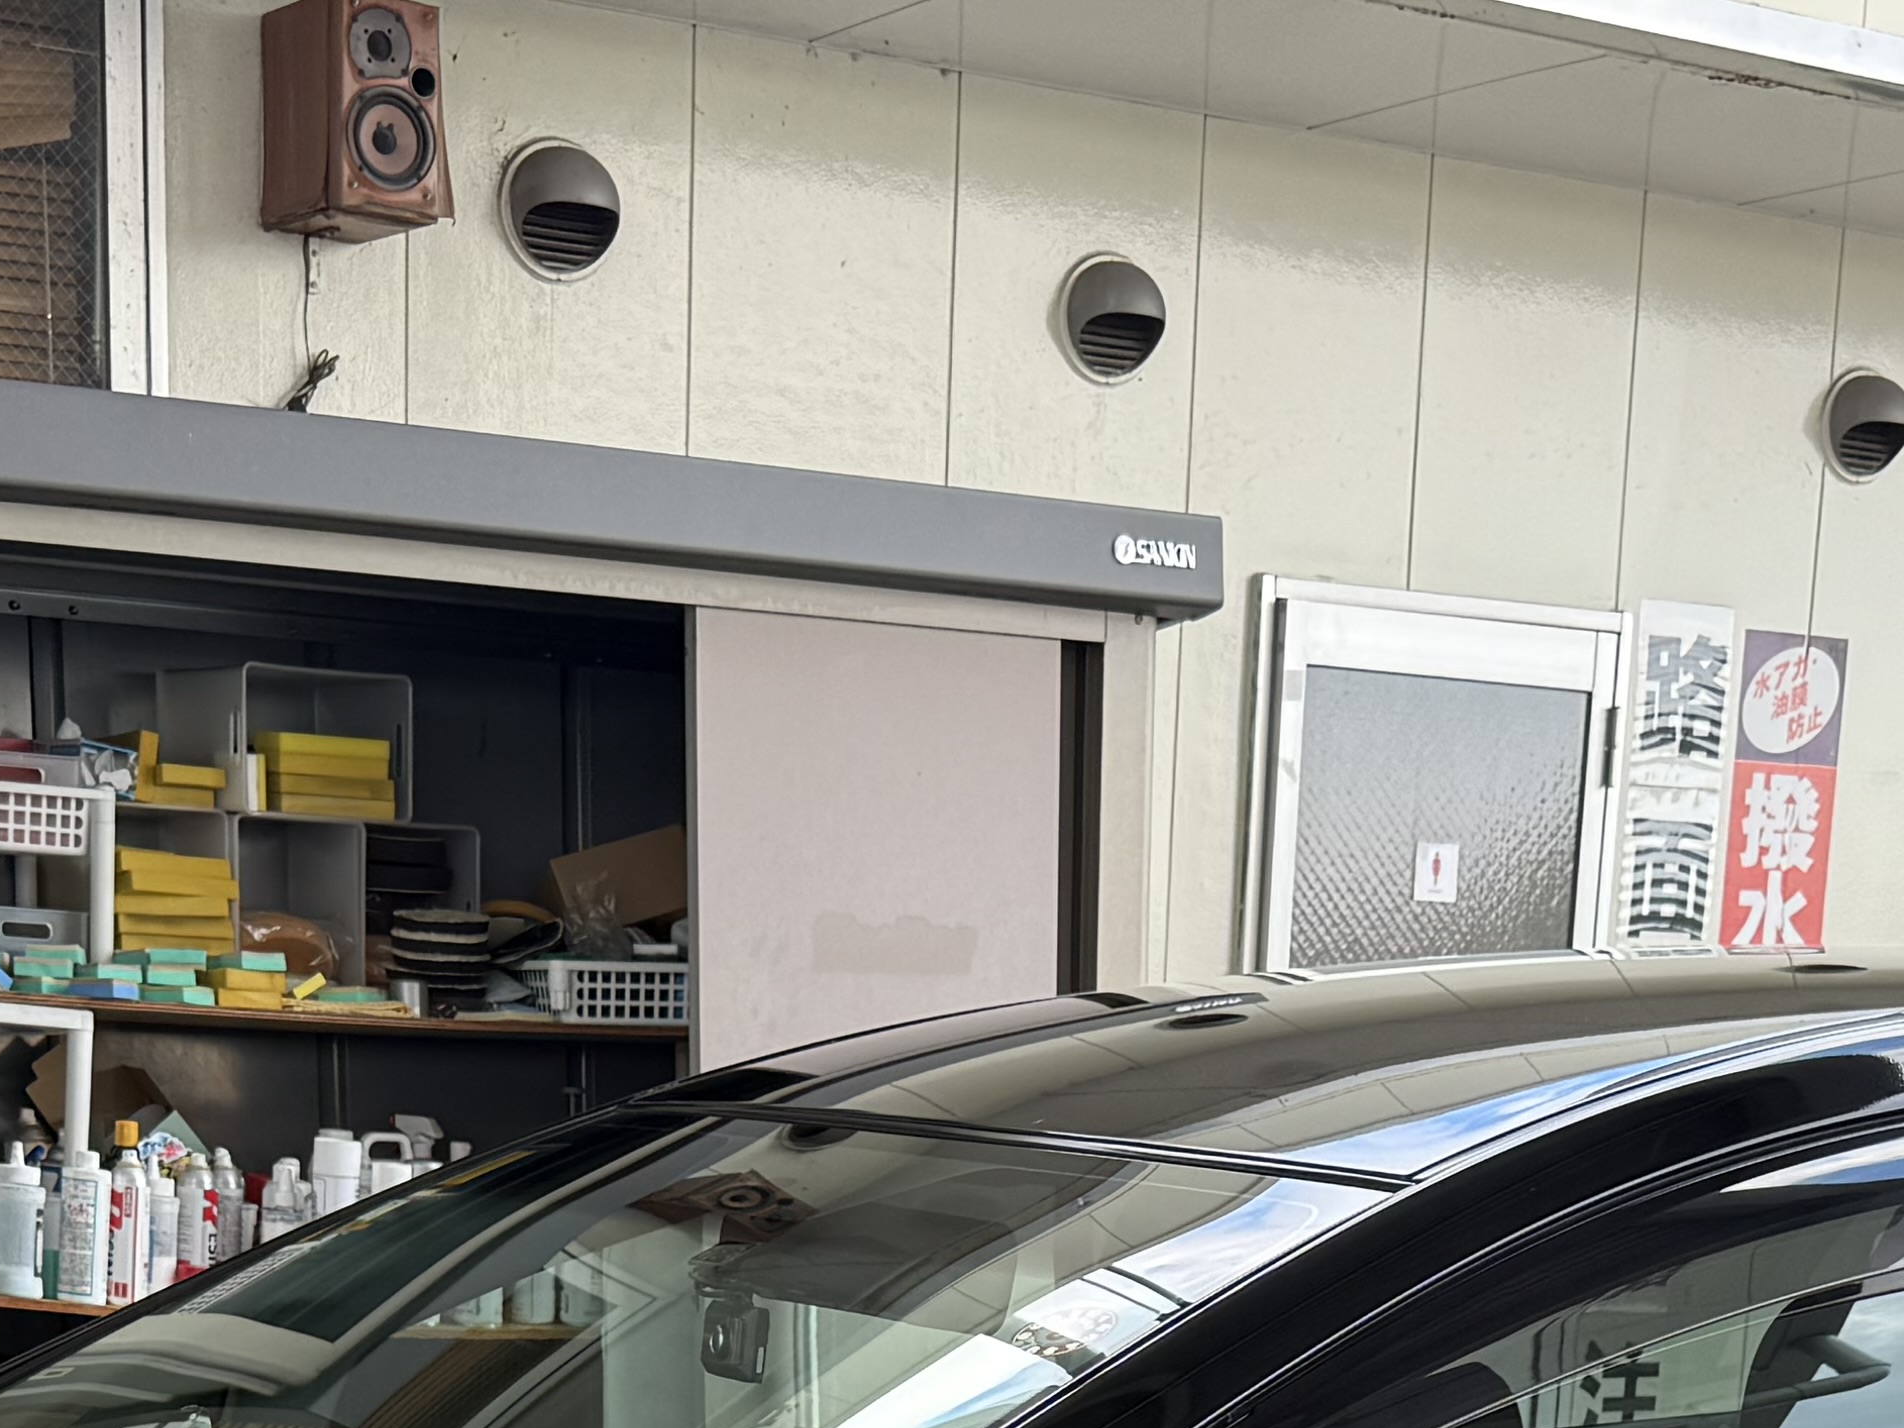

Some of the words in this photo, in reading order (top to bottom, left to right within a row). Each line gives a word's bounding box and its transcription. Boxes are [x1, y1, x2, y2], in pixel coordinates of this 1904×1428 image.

[1770, 682, 1809, 721] 油膜
[1787, 705, 1824, 745] 防止
[1732, 772, 1820, 946] 撥水
